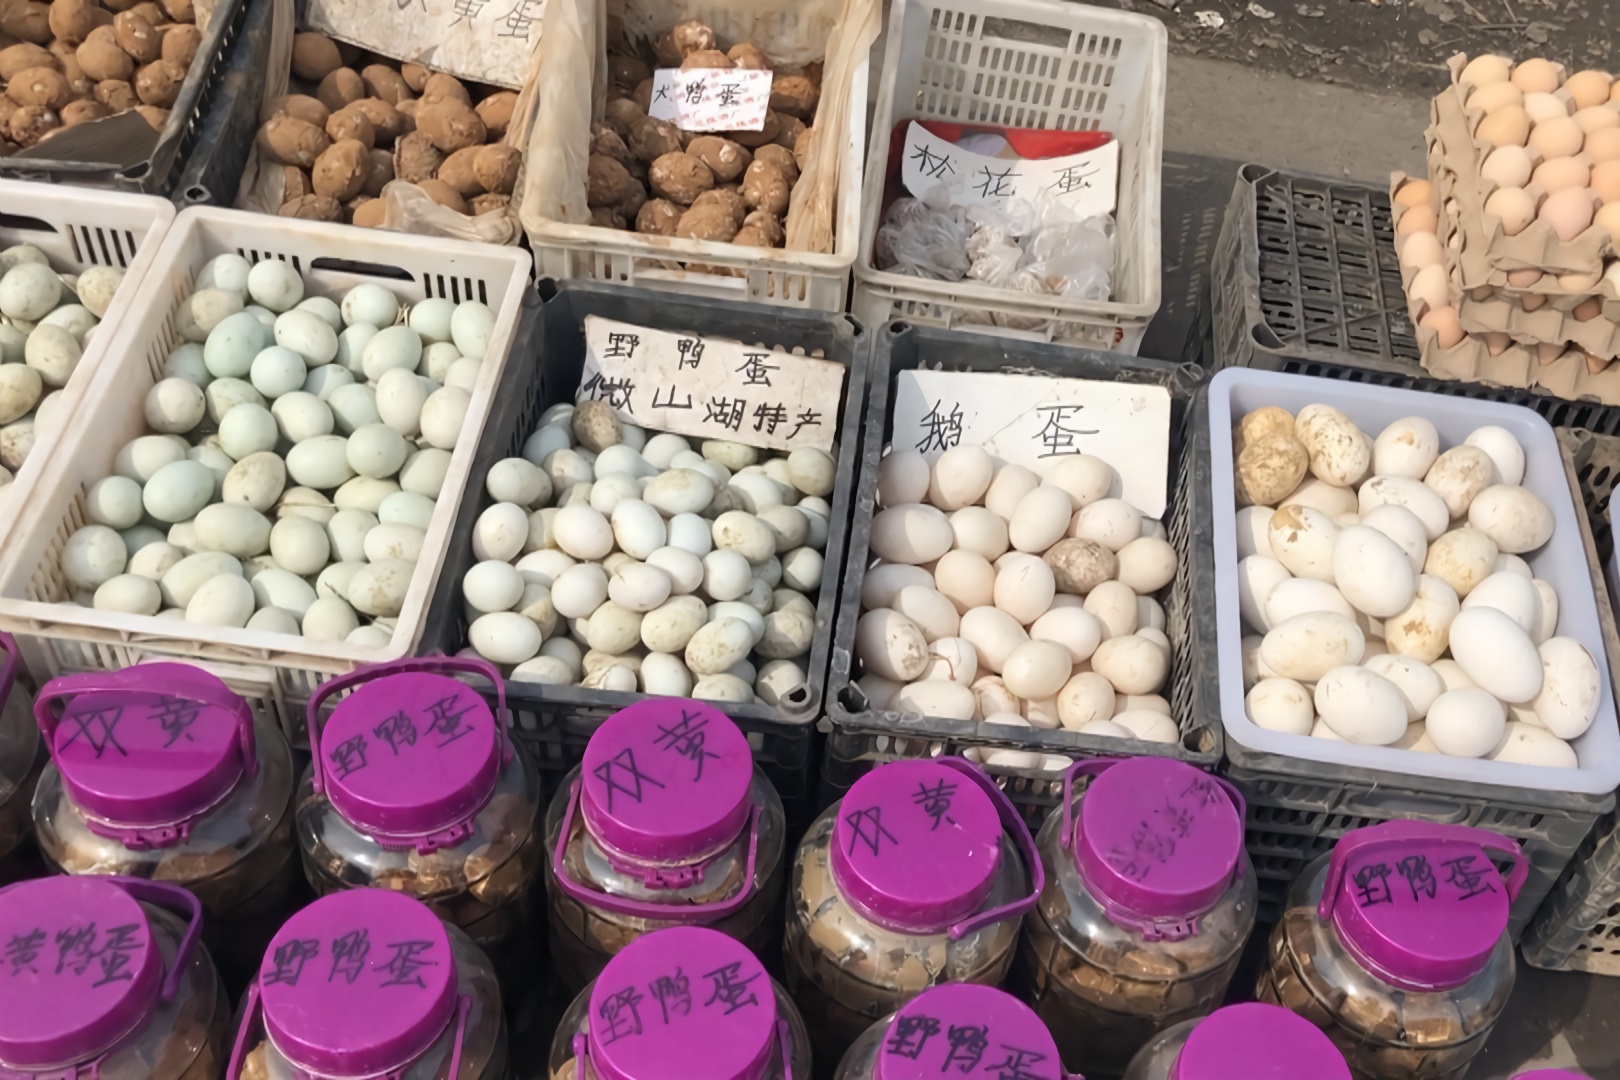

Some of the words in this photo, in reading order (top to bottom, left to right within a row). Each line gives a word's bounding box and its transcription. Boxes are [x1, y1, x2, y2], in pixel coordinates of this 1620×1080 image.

[397, 0, 543, 43] 黄蛋
[910, 143, 1101, 198] 松花蛋
[602, 331, 781, 388] 野鸭蛋
[583, 370, 823, 441] 微山湖特产
[914, 398, 1101, 460] 鹅蛋
[57, 696, 212, 760] 双黄
[328, 692, 479, 782] 野鸭蛋
[592, 708, 722, 815] 双黄
[844, 777, 959, 858] 双黄
[1350, 853, 1499, 909] 野鸭蛋
[0, 920, 147, 989] 黄鸭蛋
[261, 927, 440, 990] 野鸭蛋
[598, 960, 763, 1048] 野鸭蛋
